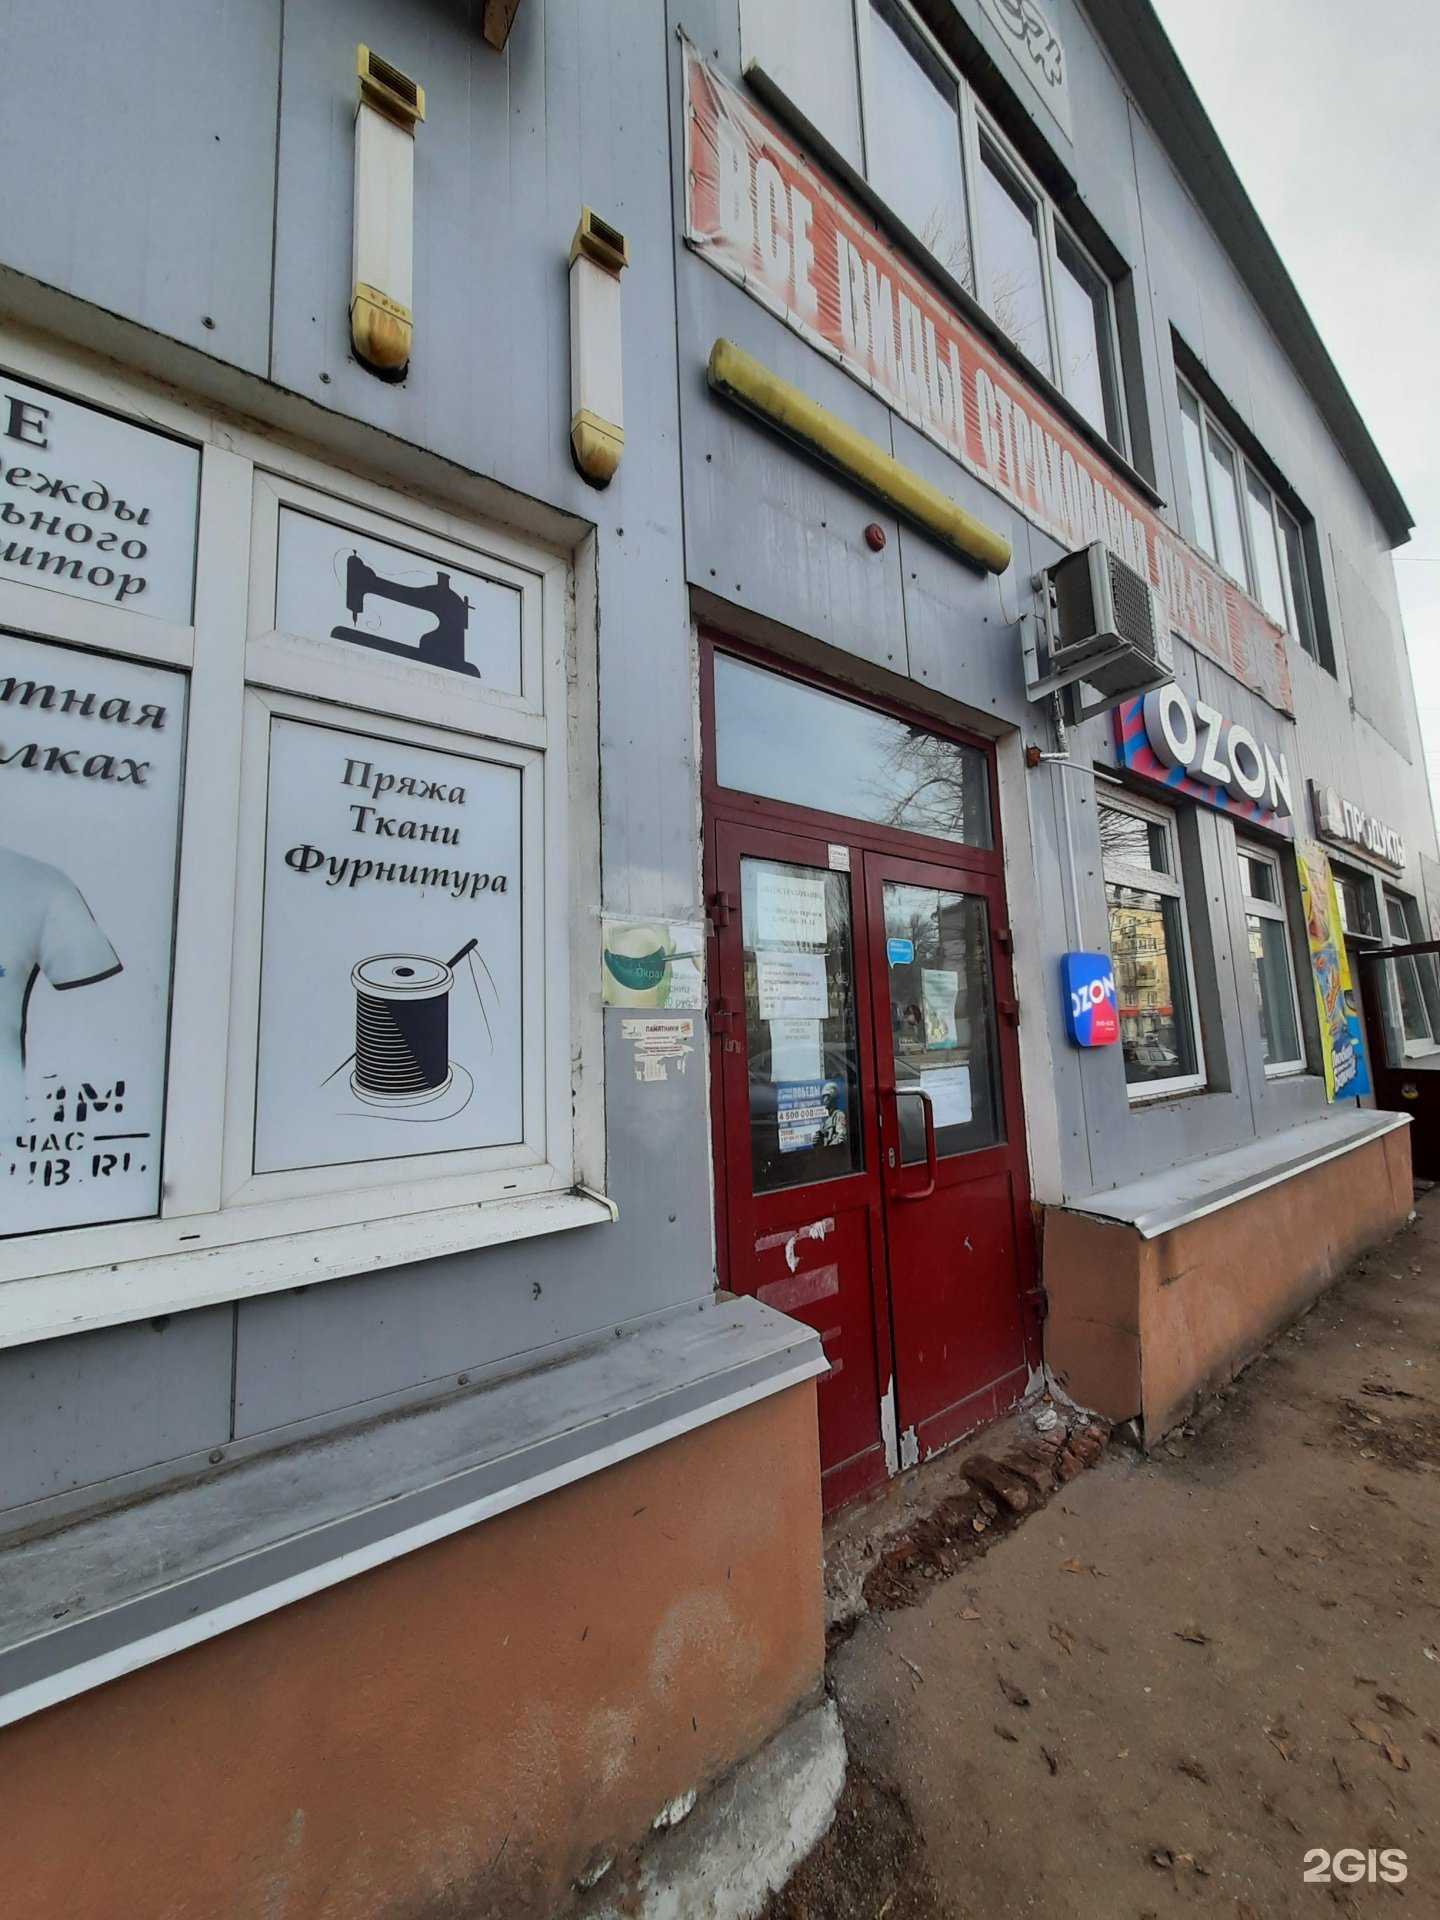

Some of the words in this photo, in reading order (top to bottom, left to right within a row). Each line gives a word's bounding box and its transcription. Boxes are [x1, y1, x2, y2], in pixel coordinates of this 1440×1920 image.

[718, 112, 818, 318] ВСЕ
[836, 230, 967, 464] ВИДЫ
[0, 456, 150, 526] ежды
[0, 501, 148, 560] ьного
[0, 676, 167, 729] тная
[1150, 682, 1294, 817] OZON
[340, 758, 467, 805] Пряжа
[350, 804, 461, 846] Ткани
[284, 843, 509, 899] Фурнитура
